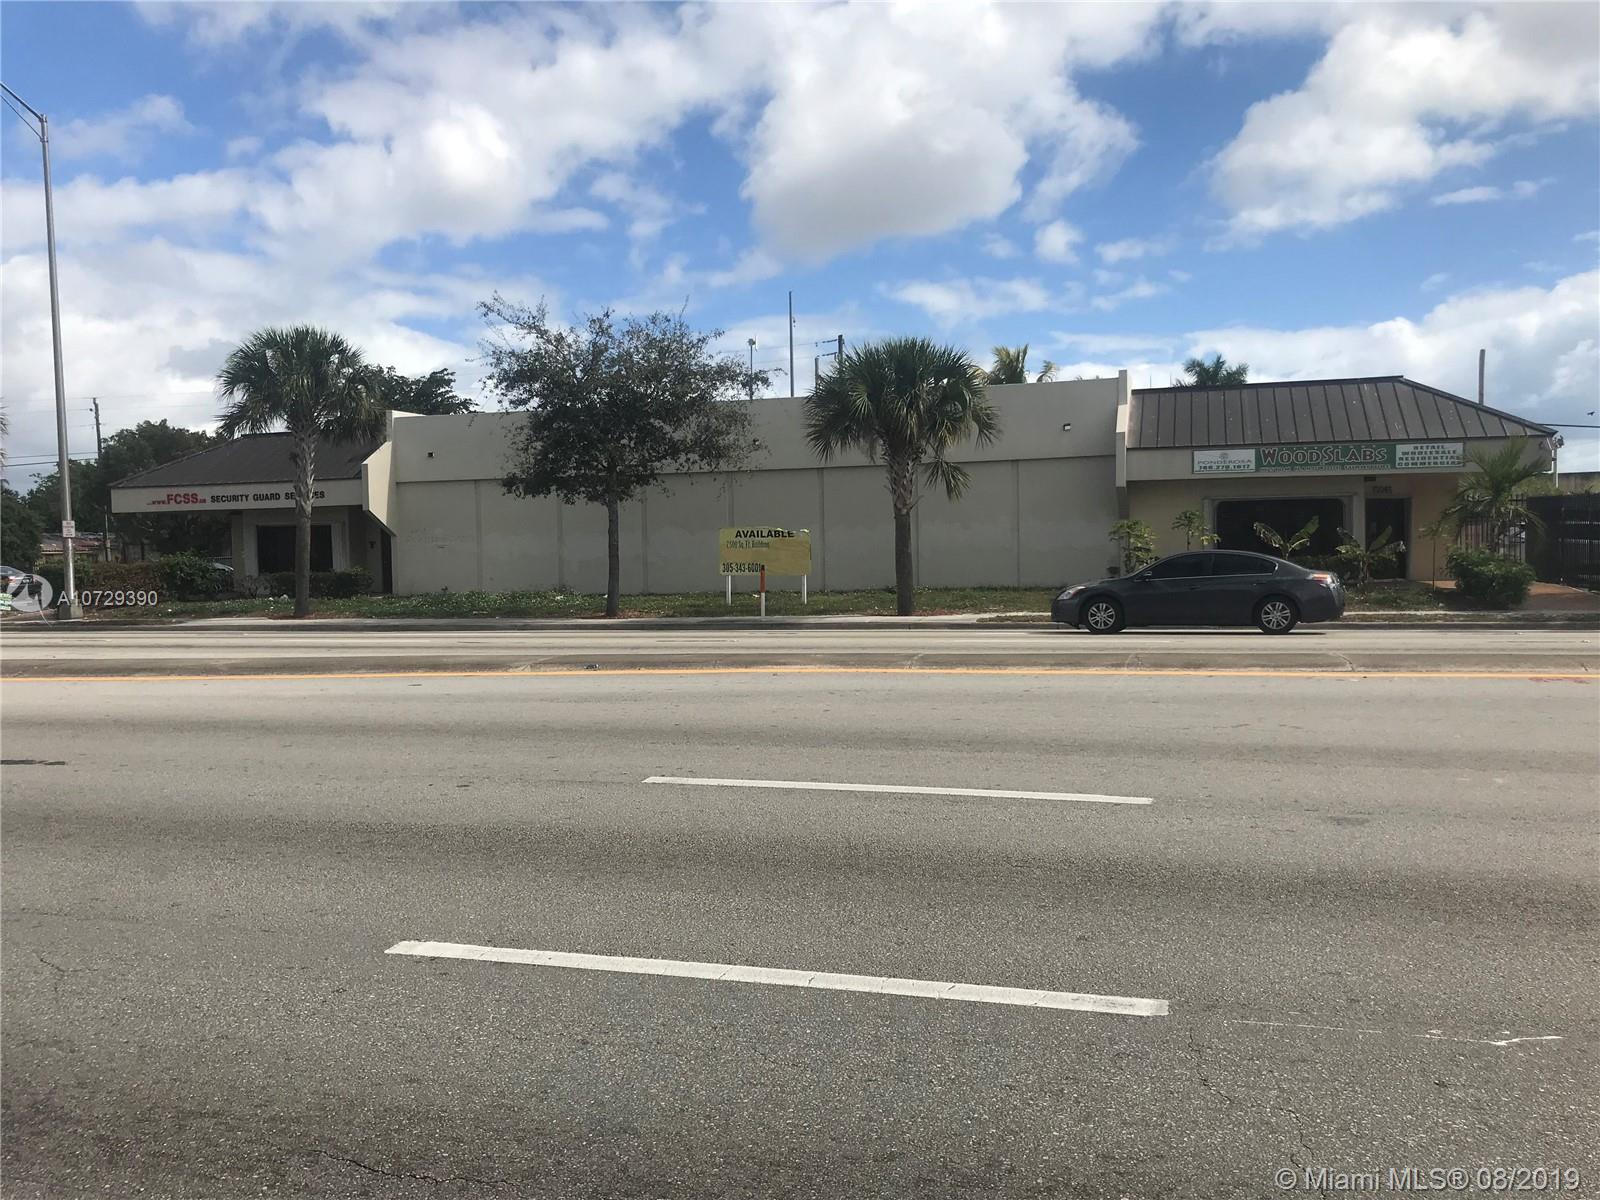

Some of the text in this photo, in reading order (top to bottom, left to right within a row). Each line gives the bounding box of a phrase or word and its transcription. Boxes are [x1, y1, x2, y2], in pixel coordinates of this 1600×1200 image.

[210, 494, 250, 503] SECURITY
[252, 492, 281, 502] GUARD
[284, 490, 325, 501] SEES
[735, 529, 795, 538] AVAILABLE
